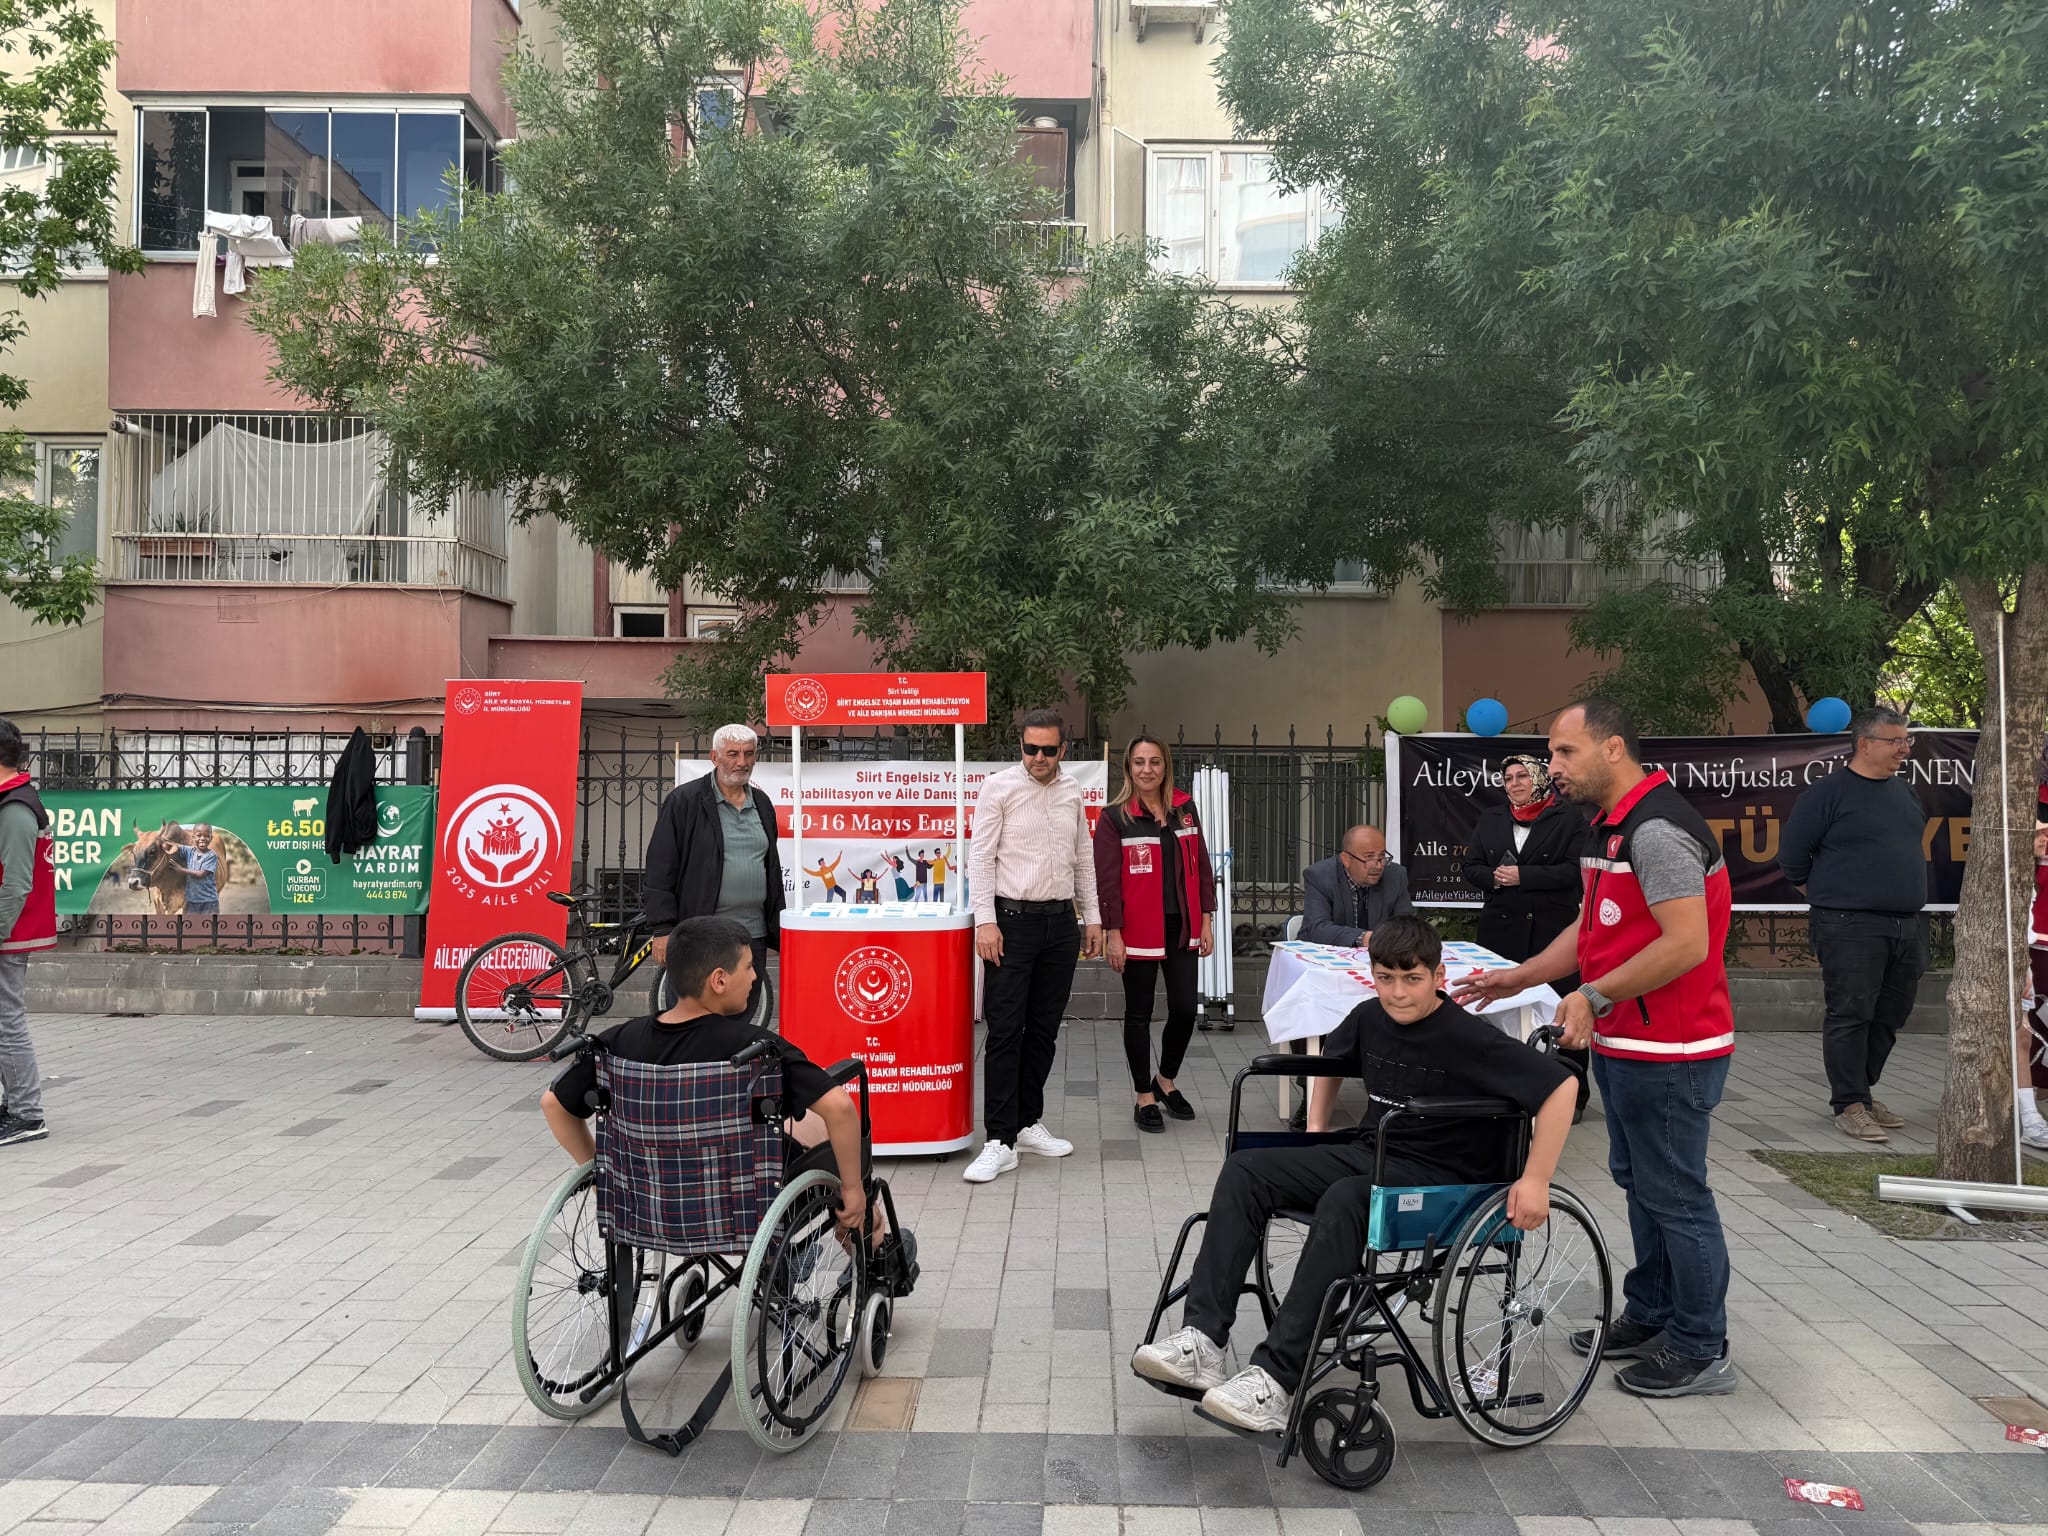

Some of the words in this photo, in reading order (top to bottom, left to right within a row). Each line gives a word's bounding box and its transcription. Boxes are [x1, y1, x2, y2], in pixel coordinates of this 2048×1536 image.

[848, 709, 856, 717] VE
[856, 771, 882, 783] Siirt
[886, 771, 940, 786] Engelsiz
[1413, 758, 1504, 796] Aileyle
[1685, 757, 1797, 798] Nüfusla
[877, 790, 891, 799] ve
[895, 788, 920, 799] Aile
[787, 813, 845, 831] 10-16
[851, 813, 911, 836] Mayıs
[267, 841, 289, 849] YURT
[292, 841, 310, 850] DIŞI
[1413, 841, 1448, 856] Aile
[353, 845, 423, 860] HAYRAT
[353, 863, 419, 873] YARDIM
[287, 875, 320, 884] KURBAN
[353, 879, 423, 889] hayratyardim.org
[286, 883, 321, 892] VİDEONU
[446, 867, 475, 898] 2025
[481, 893, 518, 906] AİLE
[525, 870, 553, 896] YILI
[293, 893, 314, 903] İZLE
[366, 891, 384, 899] 444
[385, 891, 389, 899] 3
[866, 1037, 880, 1046] T.C.
[851, 1052, 867, 1062] Siirt
[869, 1052, 896, 1063] Valiliği
[871, 1067, 898, 1077] BAKIM
[900, 1062, 964, 1077] REHABİLİTASYON
[902, 1078, 953, 1092] MÜDÜRLÜĞÜ
